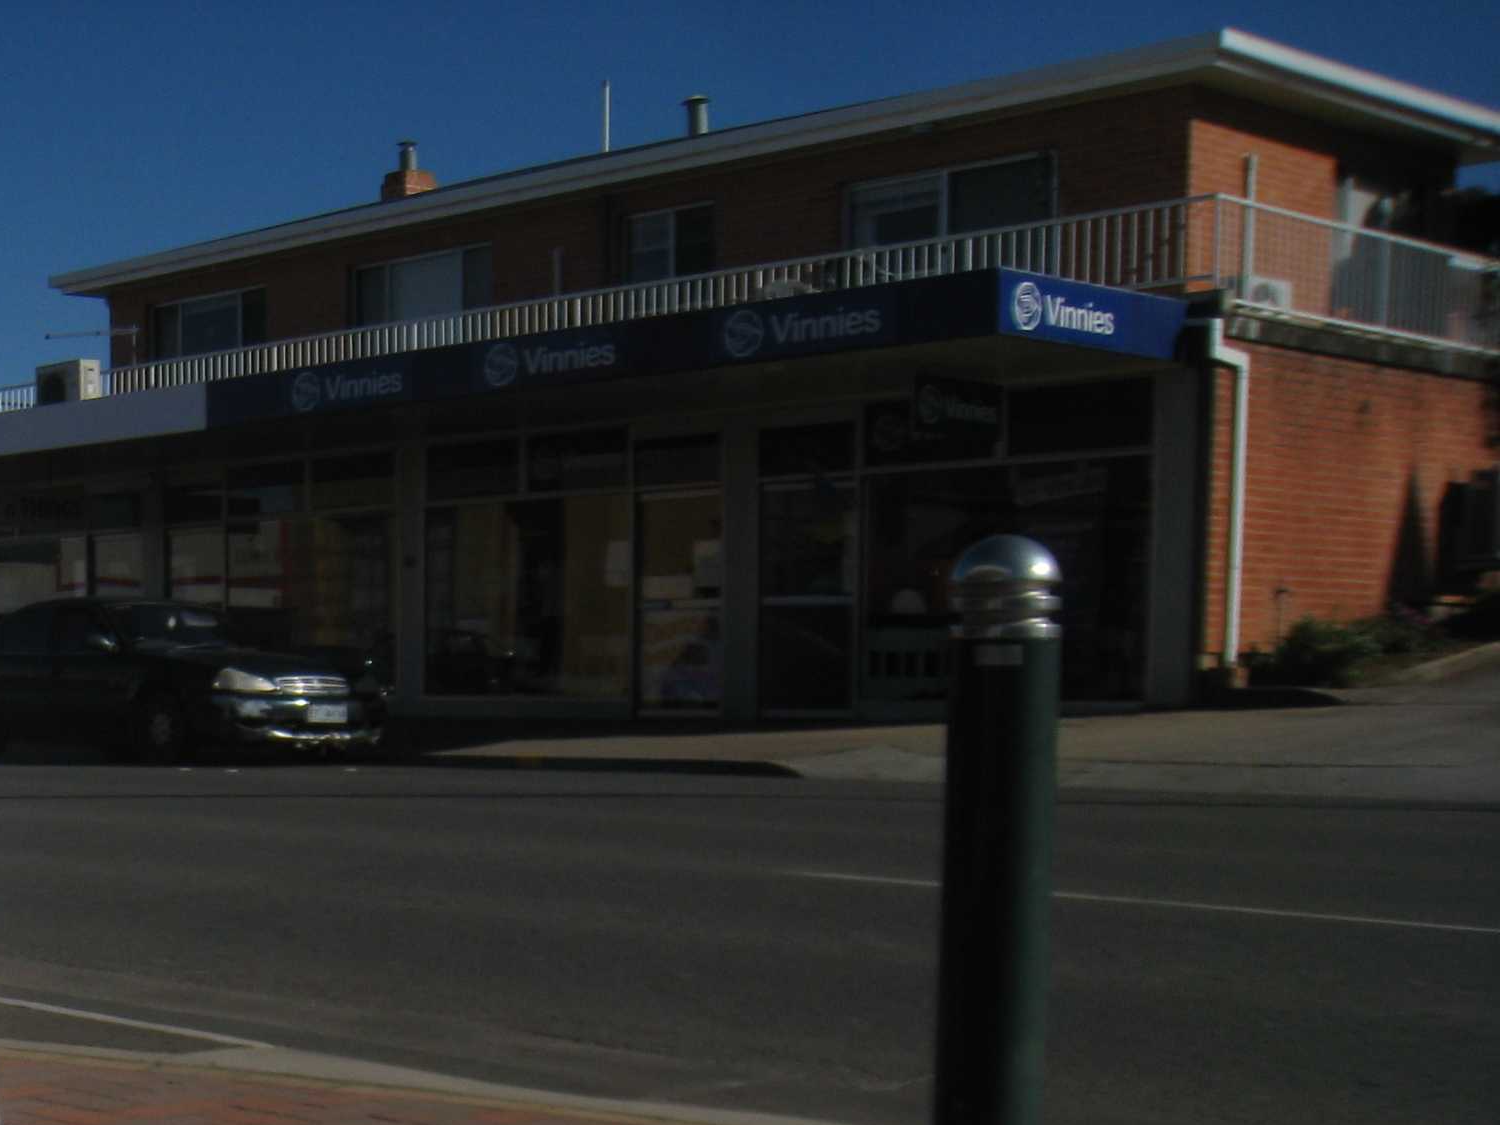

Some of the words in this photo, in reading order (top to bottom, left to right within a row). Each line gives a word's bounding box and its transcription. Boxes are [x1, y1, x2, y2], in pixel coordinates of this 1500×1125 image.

[770, 304, 882, 344] Vinnies
[1044, 294, 1115, 336] Vinnies
[523, 339, 616, 372] Vinnies
[325, 369, 403, 399] Vinnies
